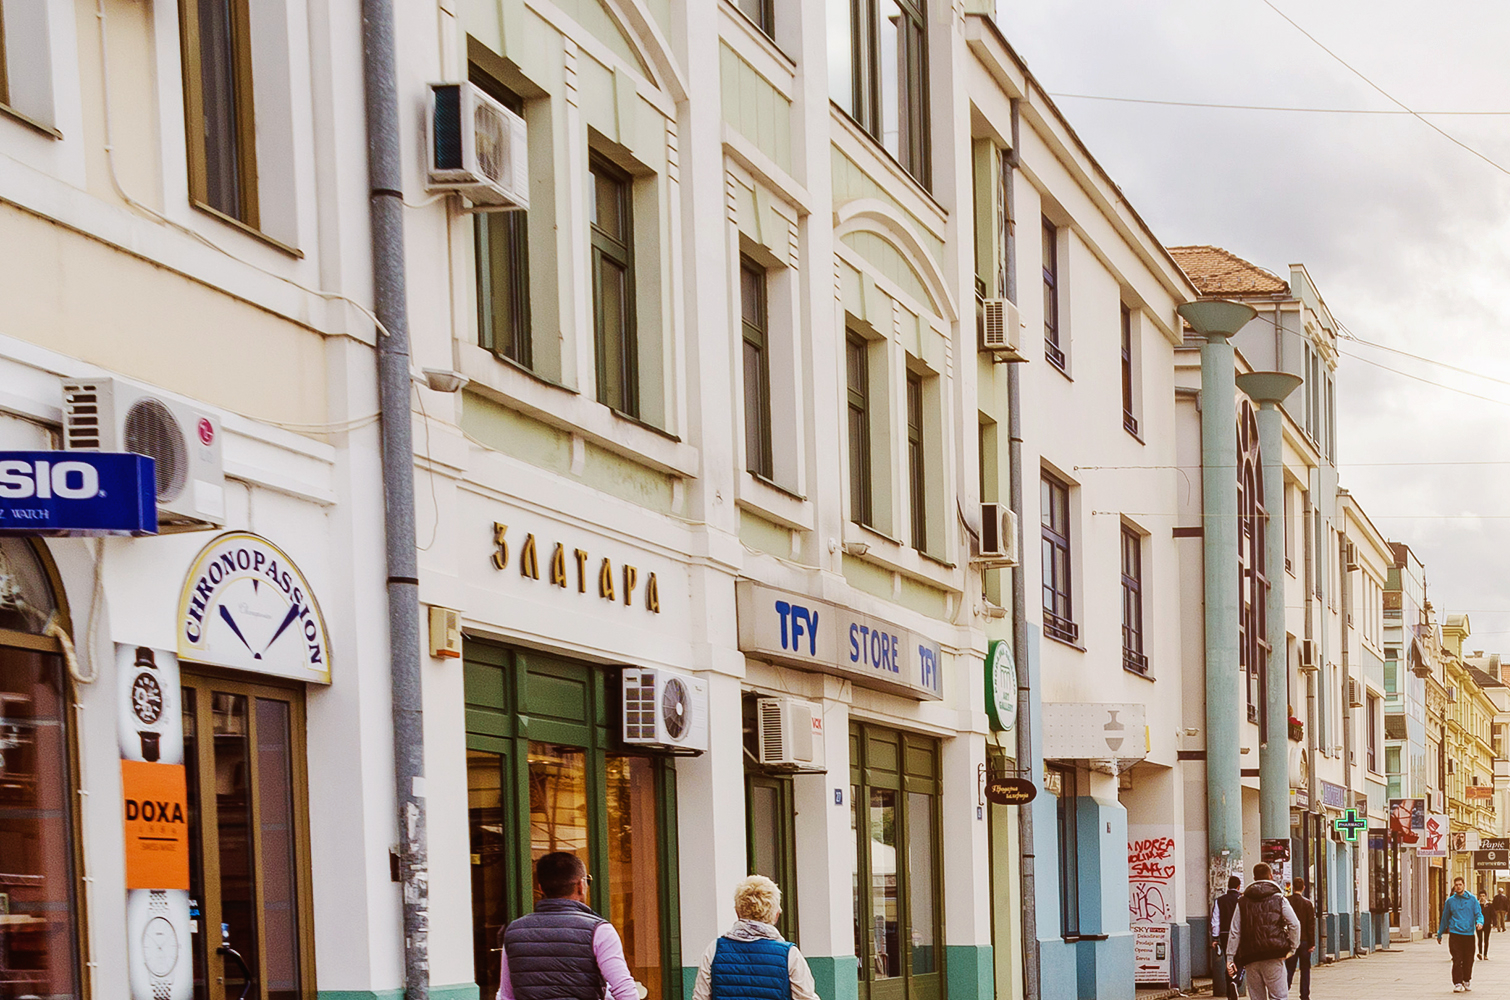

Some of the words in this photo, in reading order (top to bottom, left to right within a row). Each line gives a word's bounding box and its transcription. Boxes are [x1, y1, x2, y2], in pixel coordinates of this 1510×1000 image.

[12, 508, 50, 519] WATCH
[186, 548, 323, 665] CHRONOPASSION
[775, 599, 819, 657] TFY
[850, 622, 900, 674] STORE
[918, 644, 938, 691] TFY
[125, 799, 185, 823] DOXA
